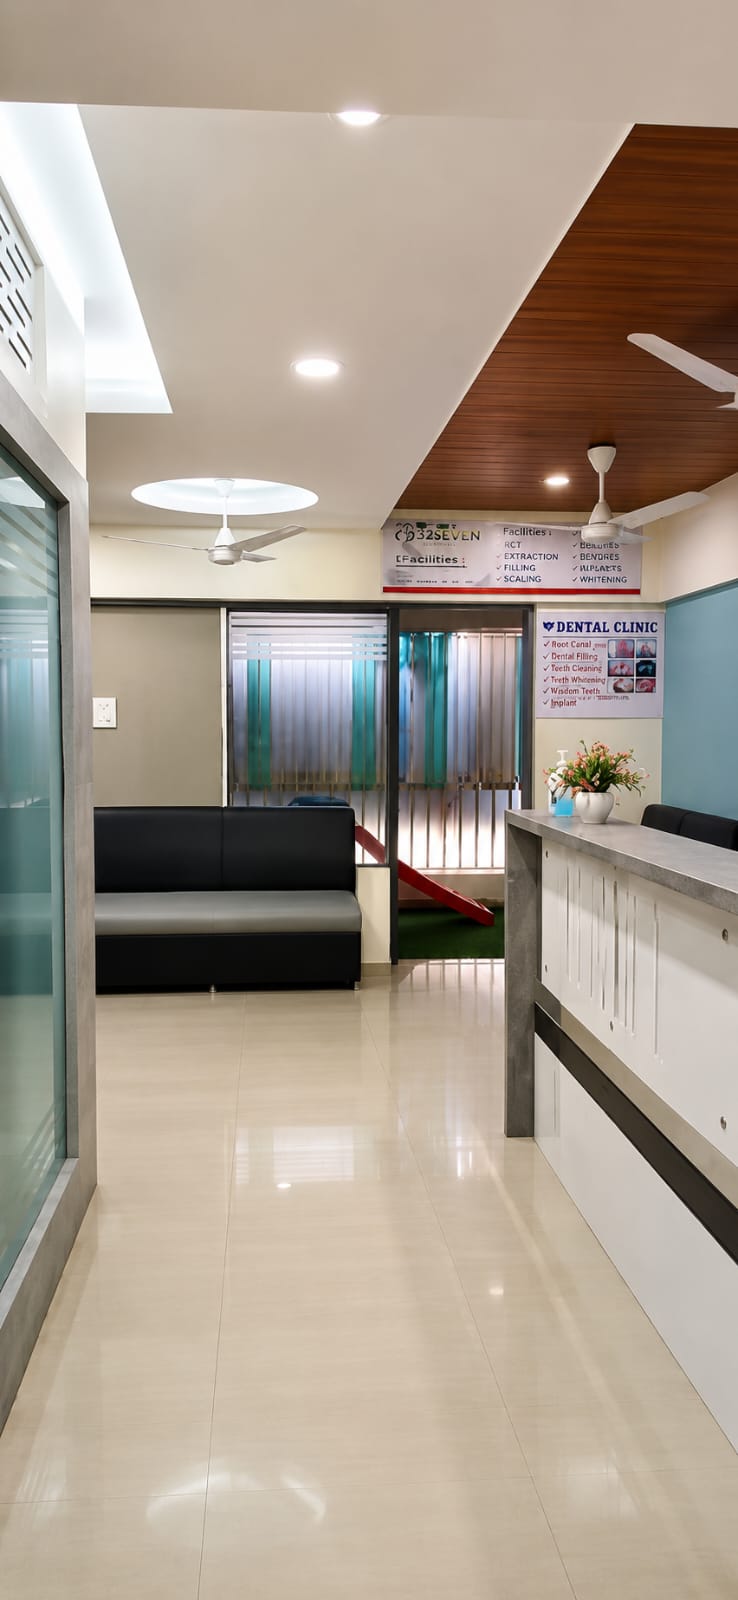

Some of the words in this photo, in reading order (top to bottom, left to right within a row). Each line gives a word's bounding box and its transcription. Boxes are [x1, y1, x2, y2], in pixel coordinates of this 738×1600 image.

[416, 529, 481, 541] 32SEVEN
[504, 541, 521, 549] RCT
[504, 553, 559, 561] EXTRACTION
[504, 564, 536, 572] FILLING
[503, 575, 542, 583] SCALING
[579, 576, 628, 584] WHITENING
[556, 621, 609, 633] DENTAL
[613, 621, 658, 633] CLINIC
[571, 640, 592, 648] Canal
[551, 652, 575, 660] Dental
[572, 664, 602, 673] Cleaning
